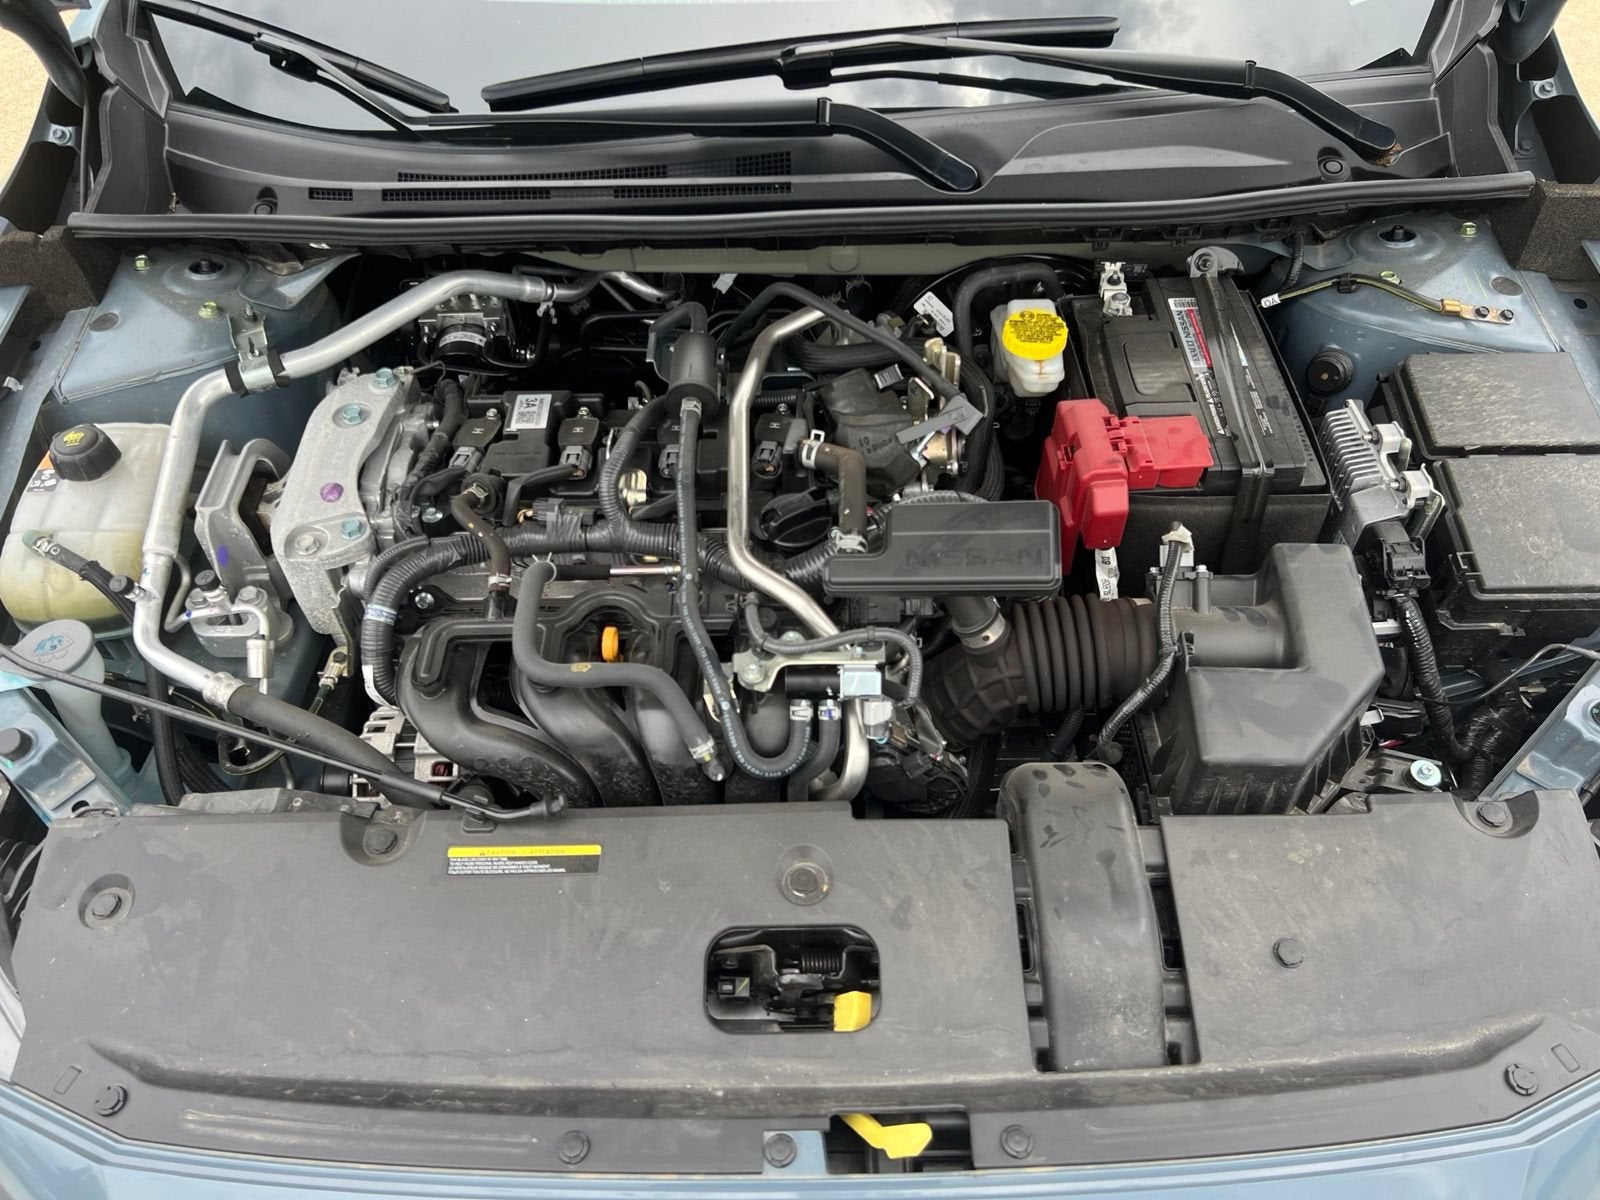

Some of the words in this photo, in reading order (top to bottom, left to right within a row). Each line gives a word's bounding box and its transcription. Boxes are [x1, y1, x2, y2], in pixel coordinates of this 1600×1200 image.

[1176, 310, 1192, 339] NISSAN
[524, 398, 538, 409] 3A
[904, 548, 1043, 568] NISSAN
